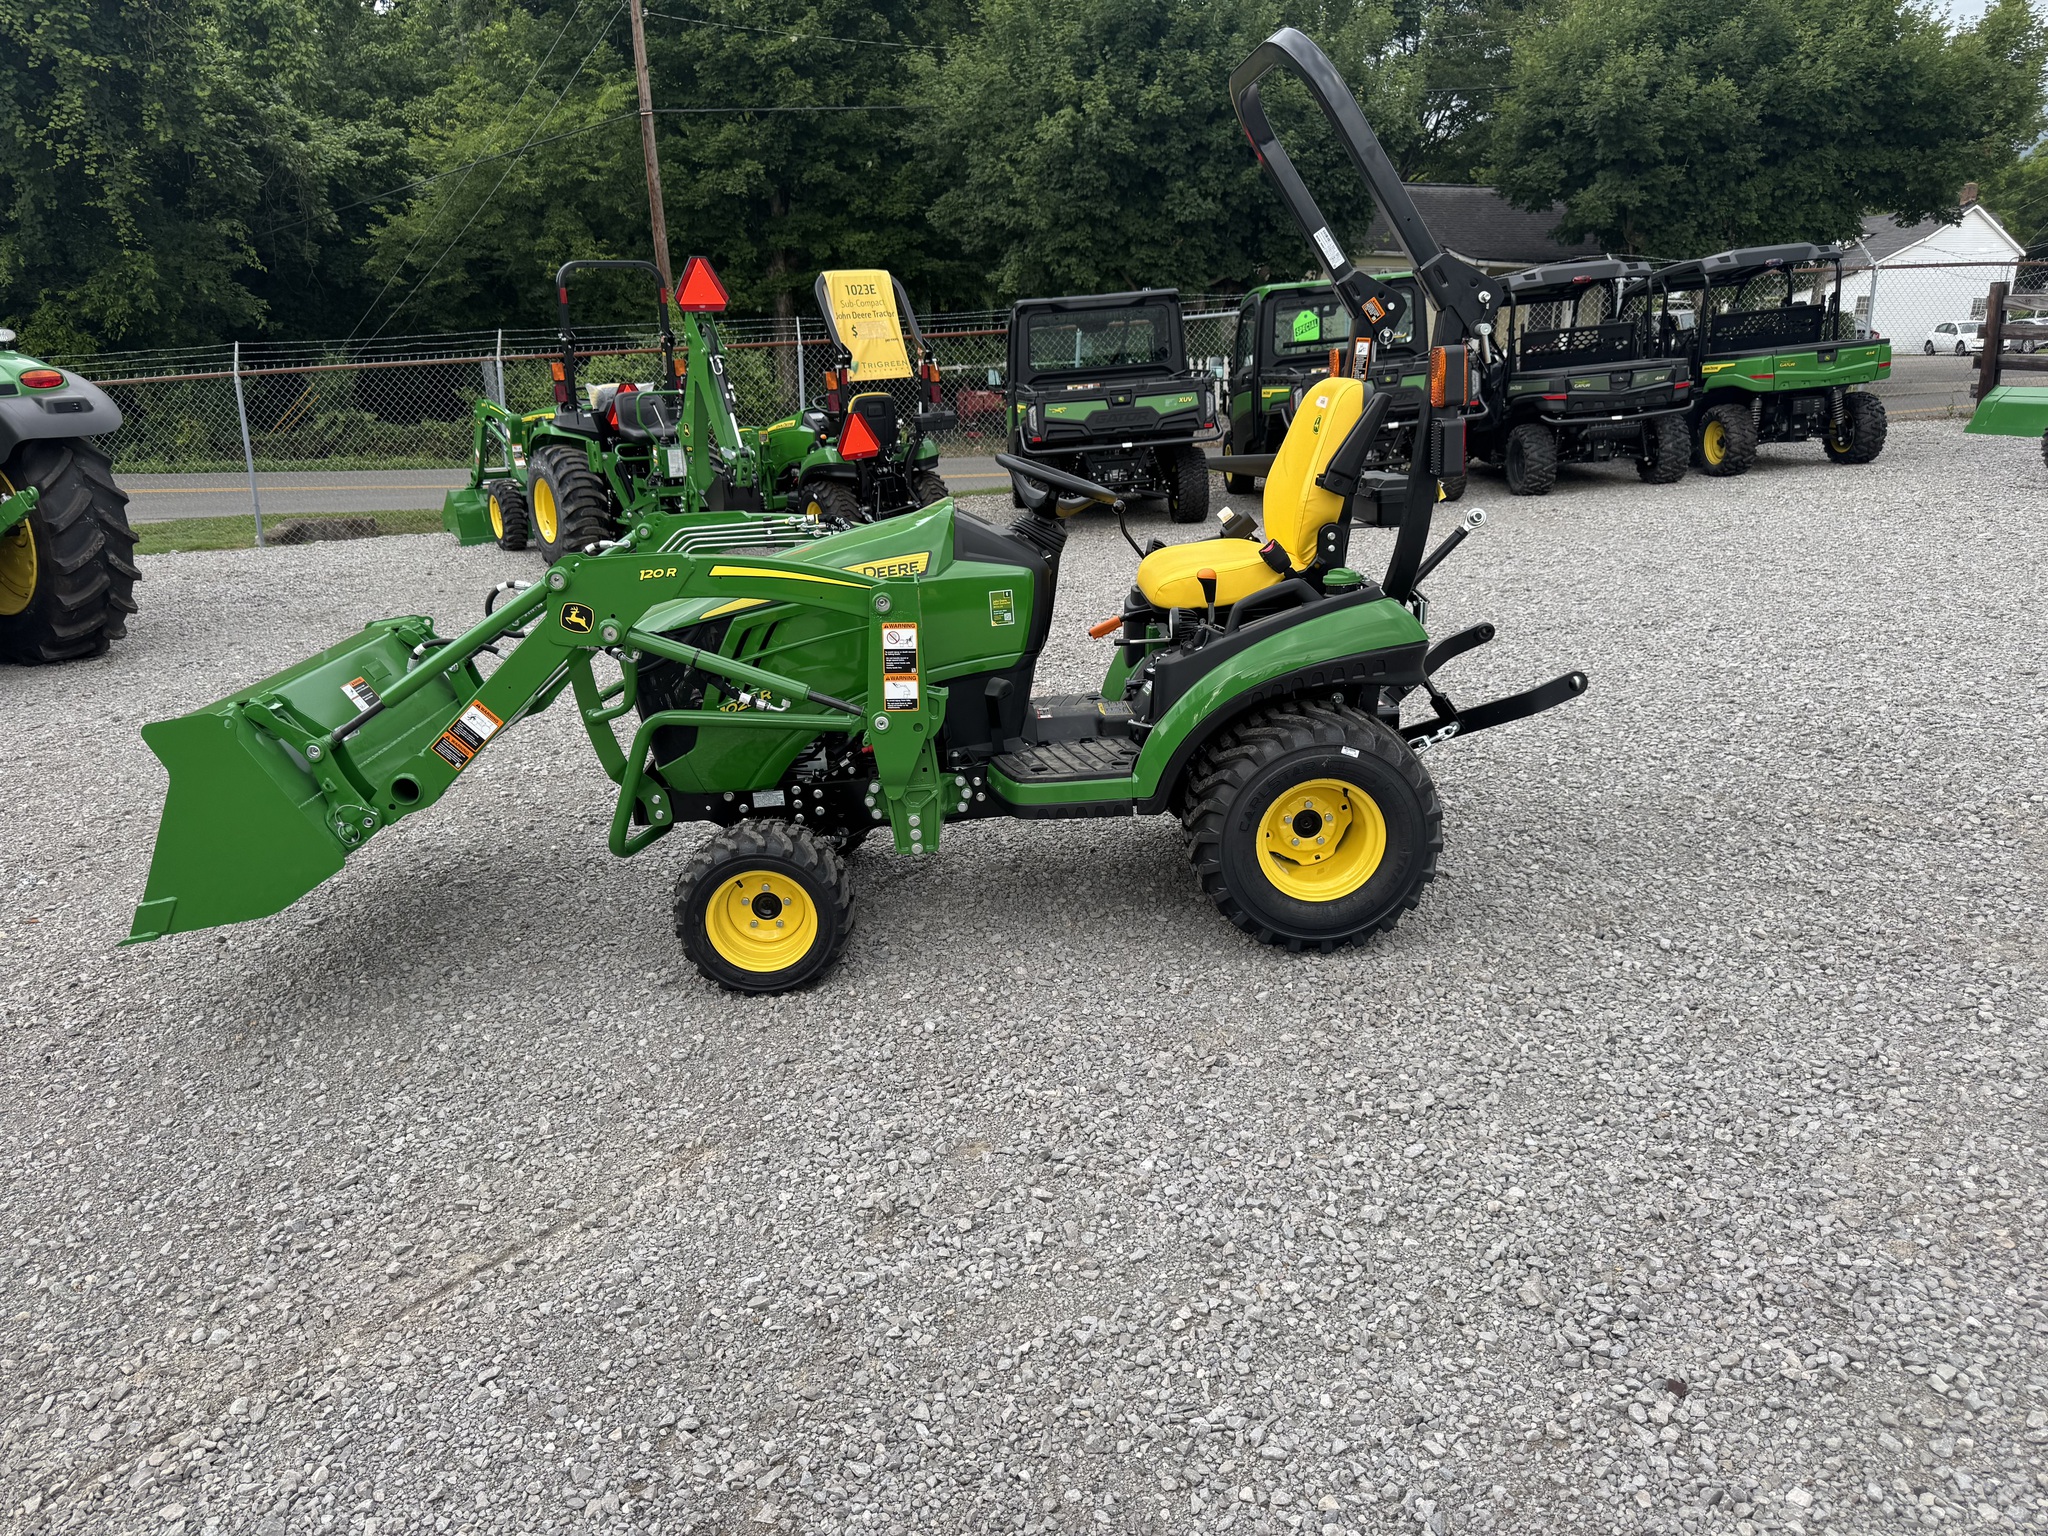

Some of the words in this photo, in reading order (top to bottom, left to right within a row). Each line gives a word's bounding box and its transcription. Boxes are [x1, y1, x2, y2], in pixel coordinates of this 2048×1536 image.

[845, 284, 877, 296] 1023E
[840, 299, 885, 309] Sub-Compact
[835, 311, 851, 320] John
[851, 311, 872, 319] Deere
[872, 310, 895, 318] Tractor
[640, 568, 664, 580] 120
[666, 567, 677, 577] R
[863, 561, 919, 579] DEERE
[480, 706, 499, 724] WARNING
[1239, 761, 1316, 833] CARLSTAR
